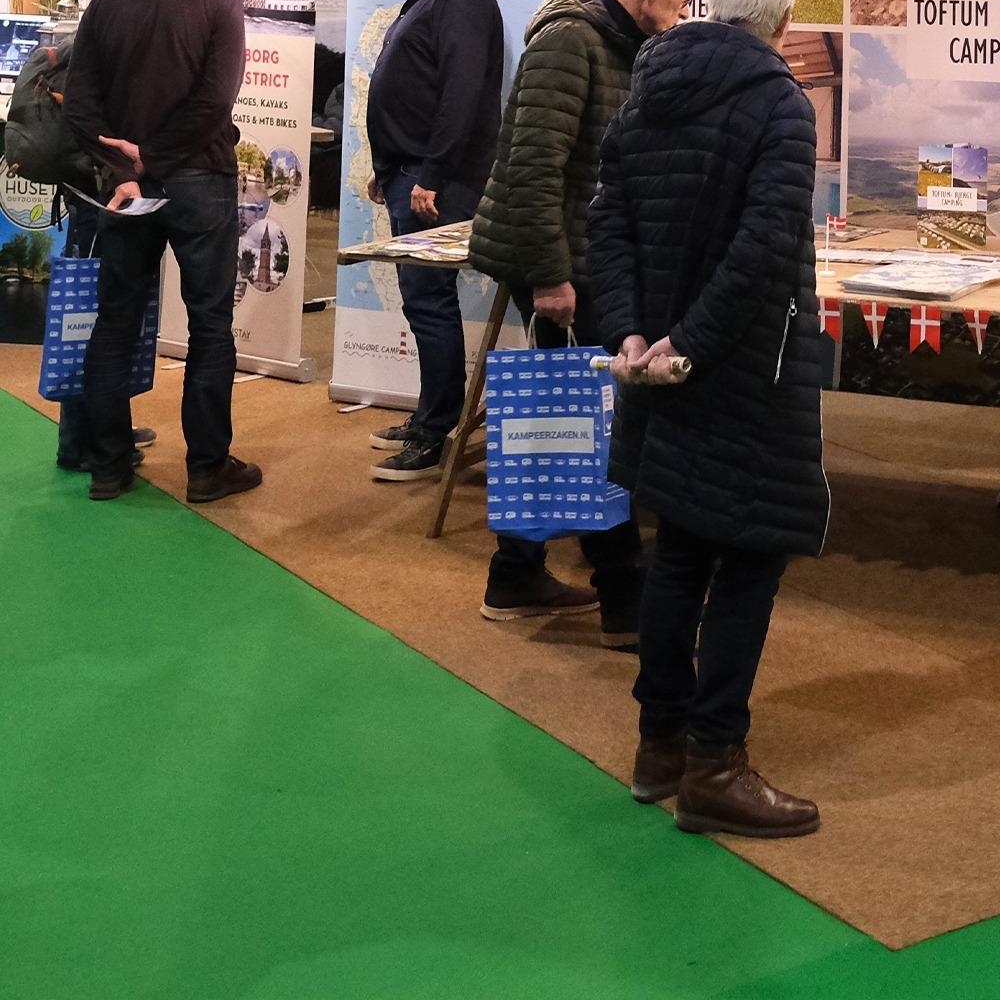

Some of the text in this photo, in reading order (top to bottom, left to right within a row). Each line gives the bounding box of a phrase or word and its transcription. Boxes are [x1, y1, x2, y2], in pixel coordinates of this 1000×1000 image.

[914, 0, 989, 27] TOFTUM
[243, 48, 279, 64] BORG
[245, 71, 289, 89] STRICT
[234, 97, 288, 110] ANOES, KAYAKS
[232, 113, 297, 129] OATS & MTB BIKES
[232, 328, 251, 340] STAY
[380, 345, 418, 358] CAMPNG
[507, 430, 591, 441] KAMPEERZAKEN.NL
